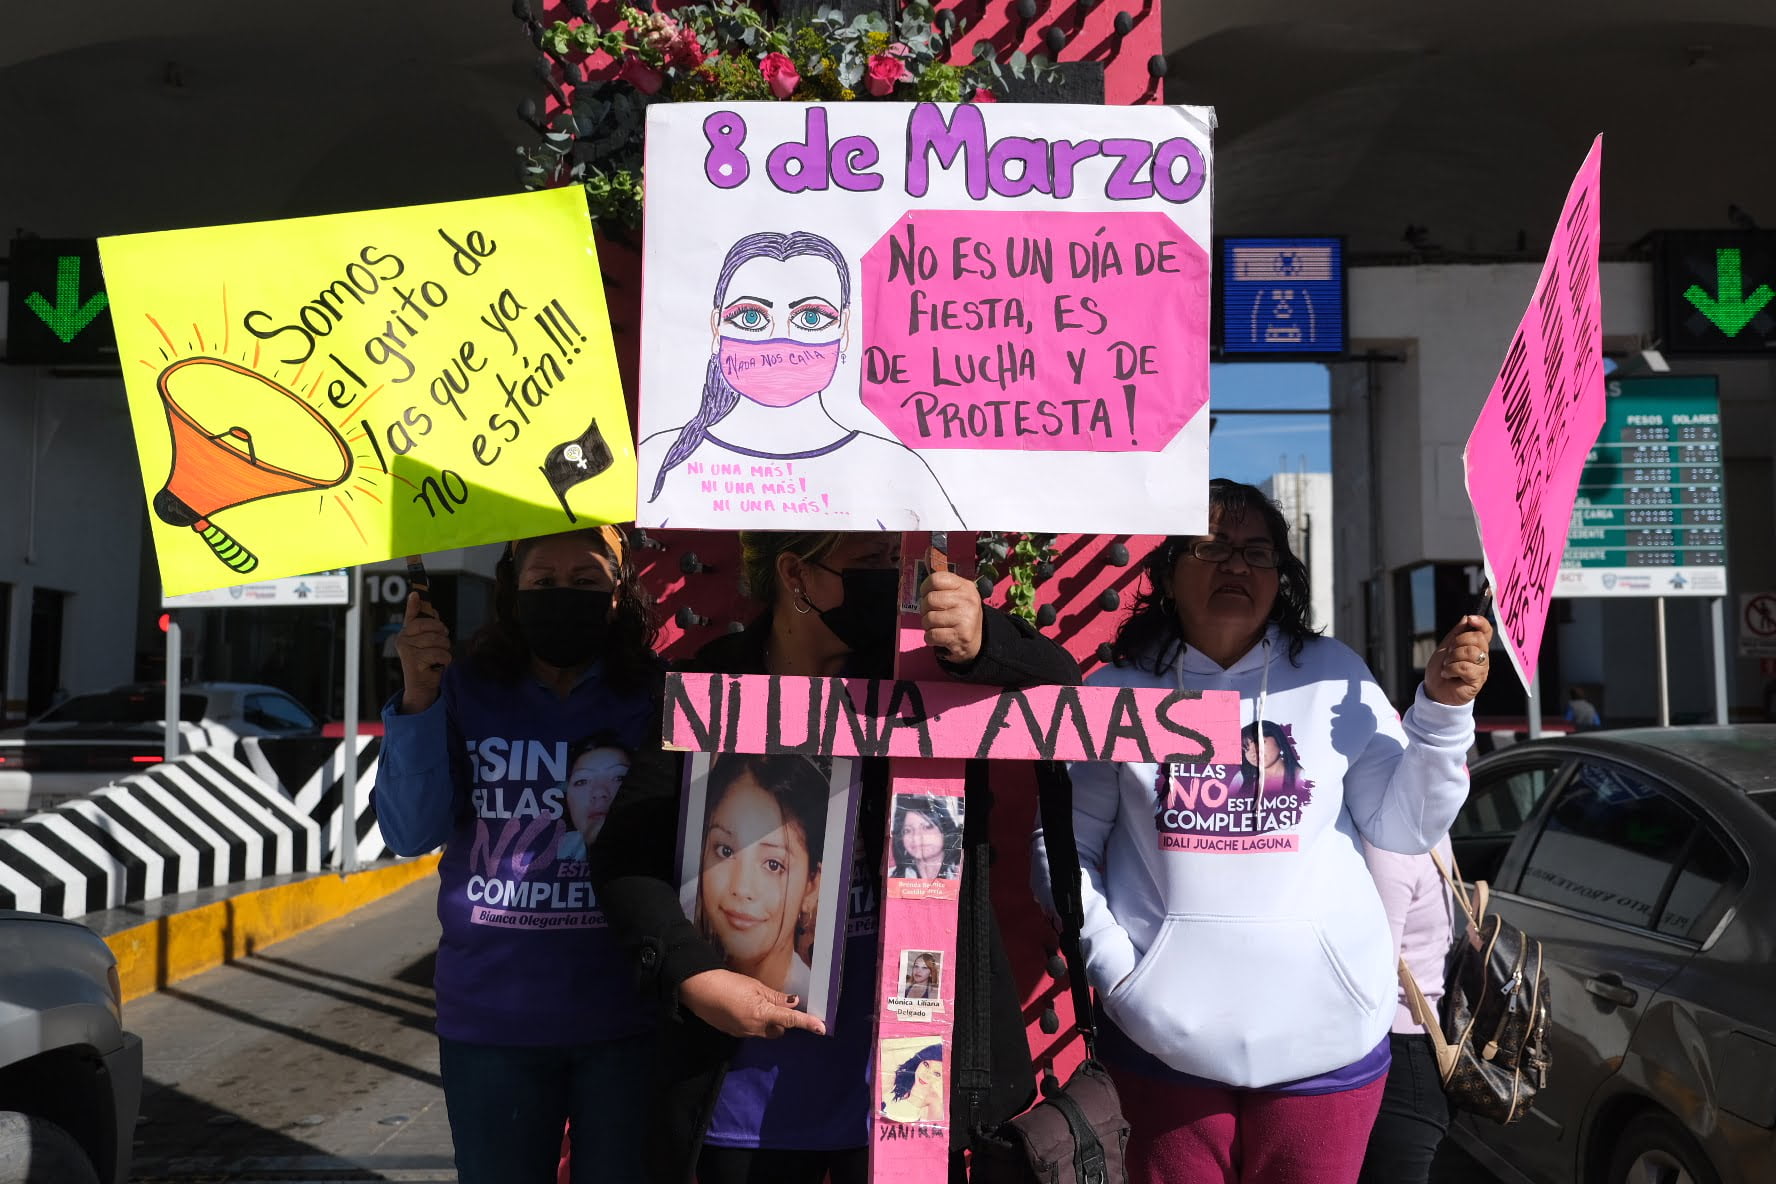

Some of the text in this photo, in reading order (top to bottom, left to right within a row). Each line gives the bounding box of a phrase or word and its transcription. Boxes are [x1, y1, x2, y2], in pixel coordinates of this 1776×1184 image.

[703, 102, 1206, 204] 8 de Marzo
[887, 223, 1181, 286] NO ES UN DÍA DE
[243, 245, 405, 364] Somos
[328, 228, 497, 408] el grito de
[908, 289, 1108, 336] FIESTA, ES
[361, 288, 528, 474] las que ya
[864, 340, 1159, 390] DE LUCHA Y DE
[412, 299, 587, 517] no están!!!
[900, 384, 1139, 446] PROTESTA!
[1627, 415, 1663, 425] PESOS
[687, 461, 704, 475] NI
[711, 463, 742, 476] UNA
[701, 480, 718, 493] NI
[724, 481, 756, 495] UNA
[713, 499, 731, 512] NI
[740, 500, 776, 512] UNA
[765, 674, 933, 757] UNA
[975, 686, 1215, 763] MAS
[1170, 763, 1226, 779] ELLAS
[1167, 775, 1229, 810] NO
[1227, 795, 1298, 811] ESTAMOS
[1163, 809, 1297, 832] COMPLETAS!
[1163, 836, 1292, 851] IDALI JUACHE LAGUNA
[466, 874, 600, 909] COMPLET
[479, 910, 517, 925] Bianca
[519, 911, 578, 928] Olegaria
[897, 1009, 926, 1017] Delgado
